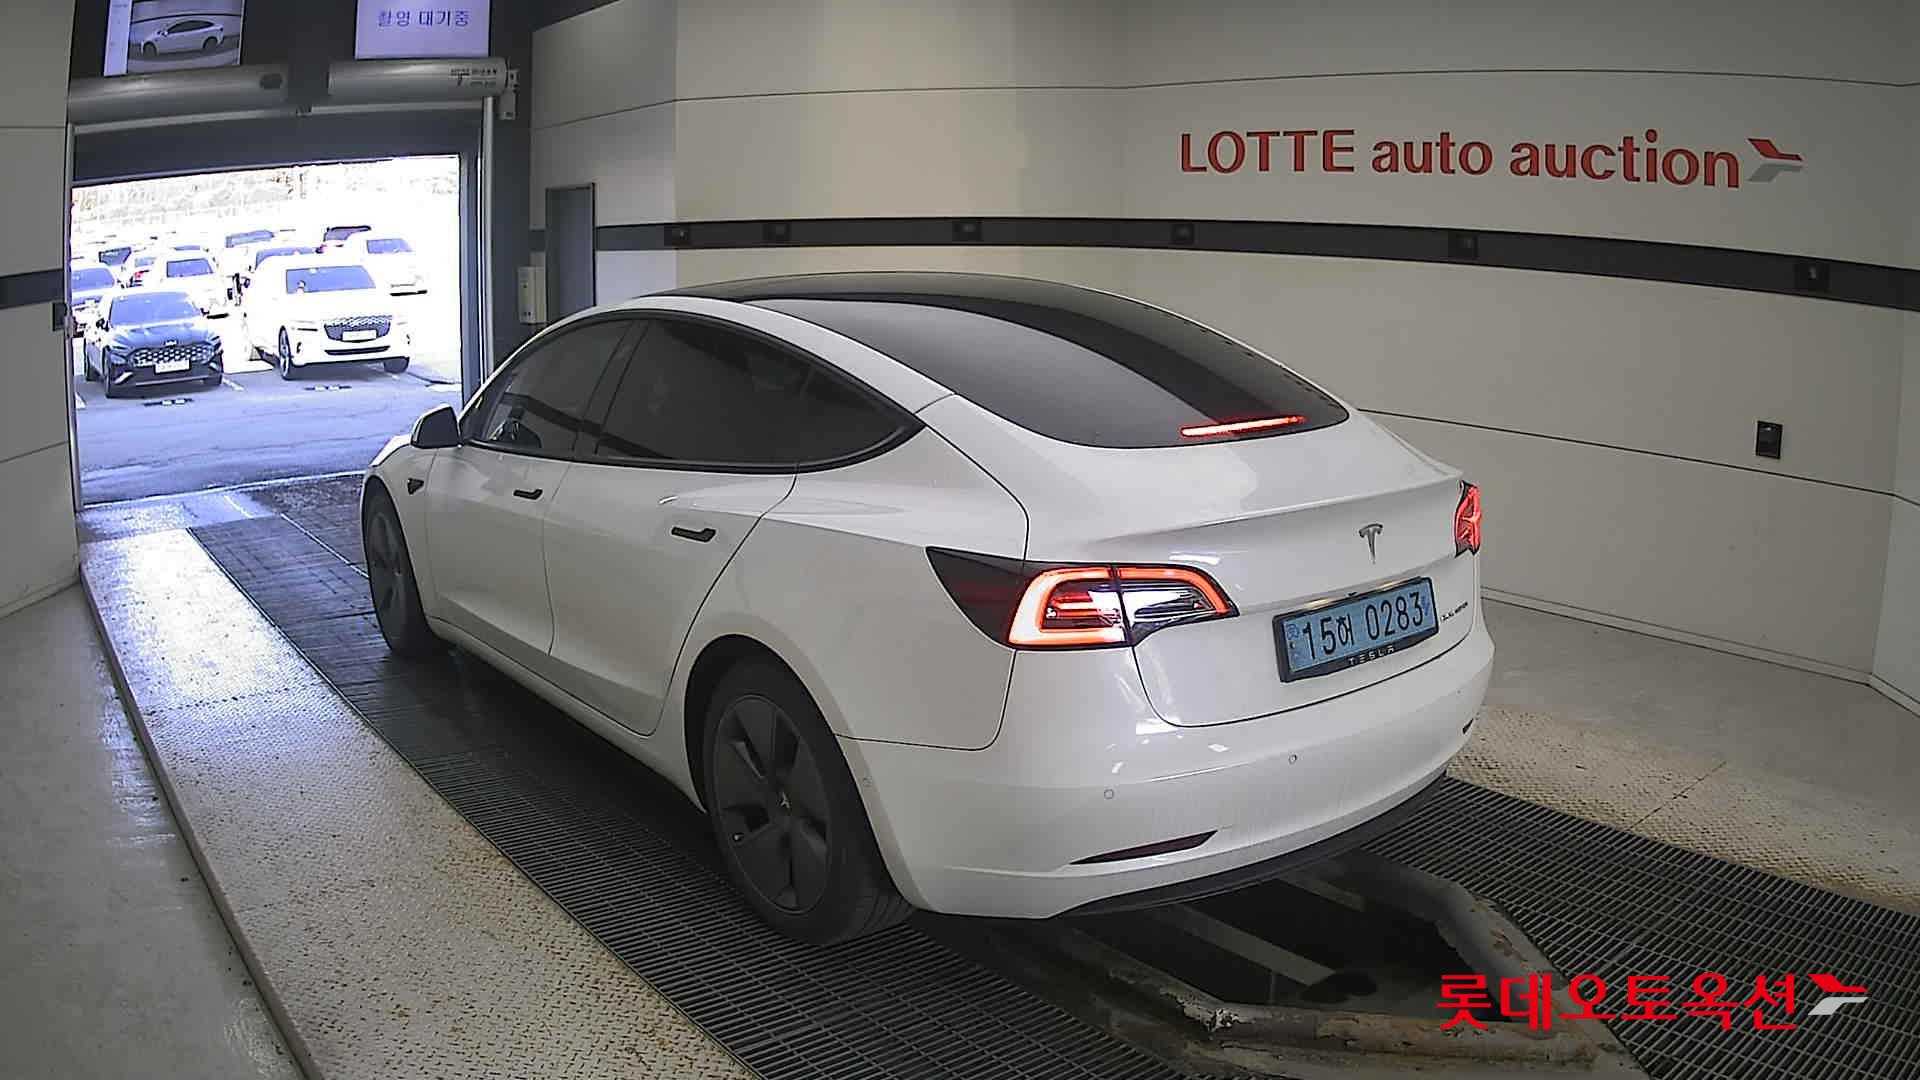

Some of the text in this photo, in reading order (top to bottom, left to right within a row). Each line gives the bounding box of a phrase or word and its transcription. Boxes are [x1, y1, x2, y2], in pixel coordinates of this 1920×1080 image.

[419, 10, 468, 27] 대기중
[1181, 128, 1740, 189] LOTTE auto auction
[1302, 612, 1354, 660] 15허
[1365, 591, 1423, 640] 0283
[1348, 645, 1395, 666] TESLA
